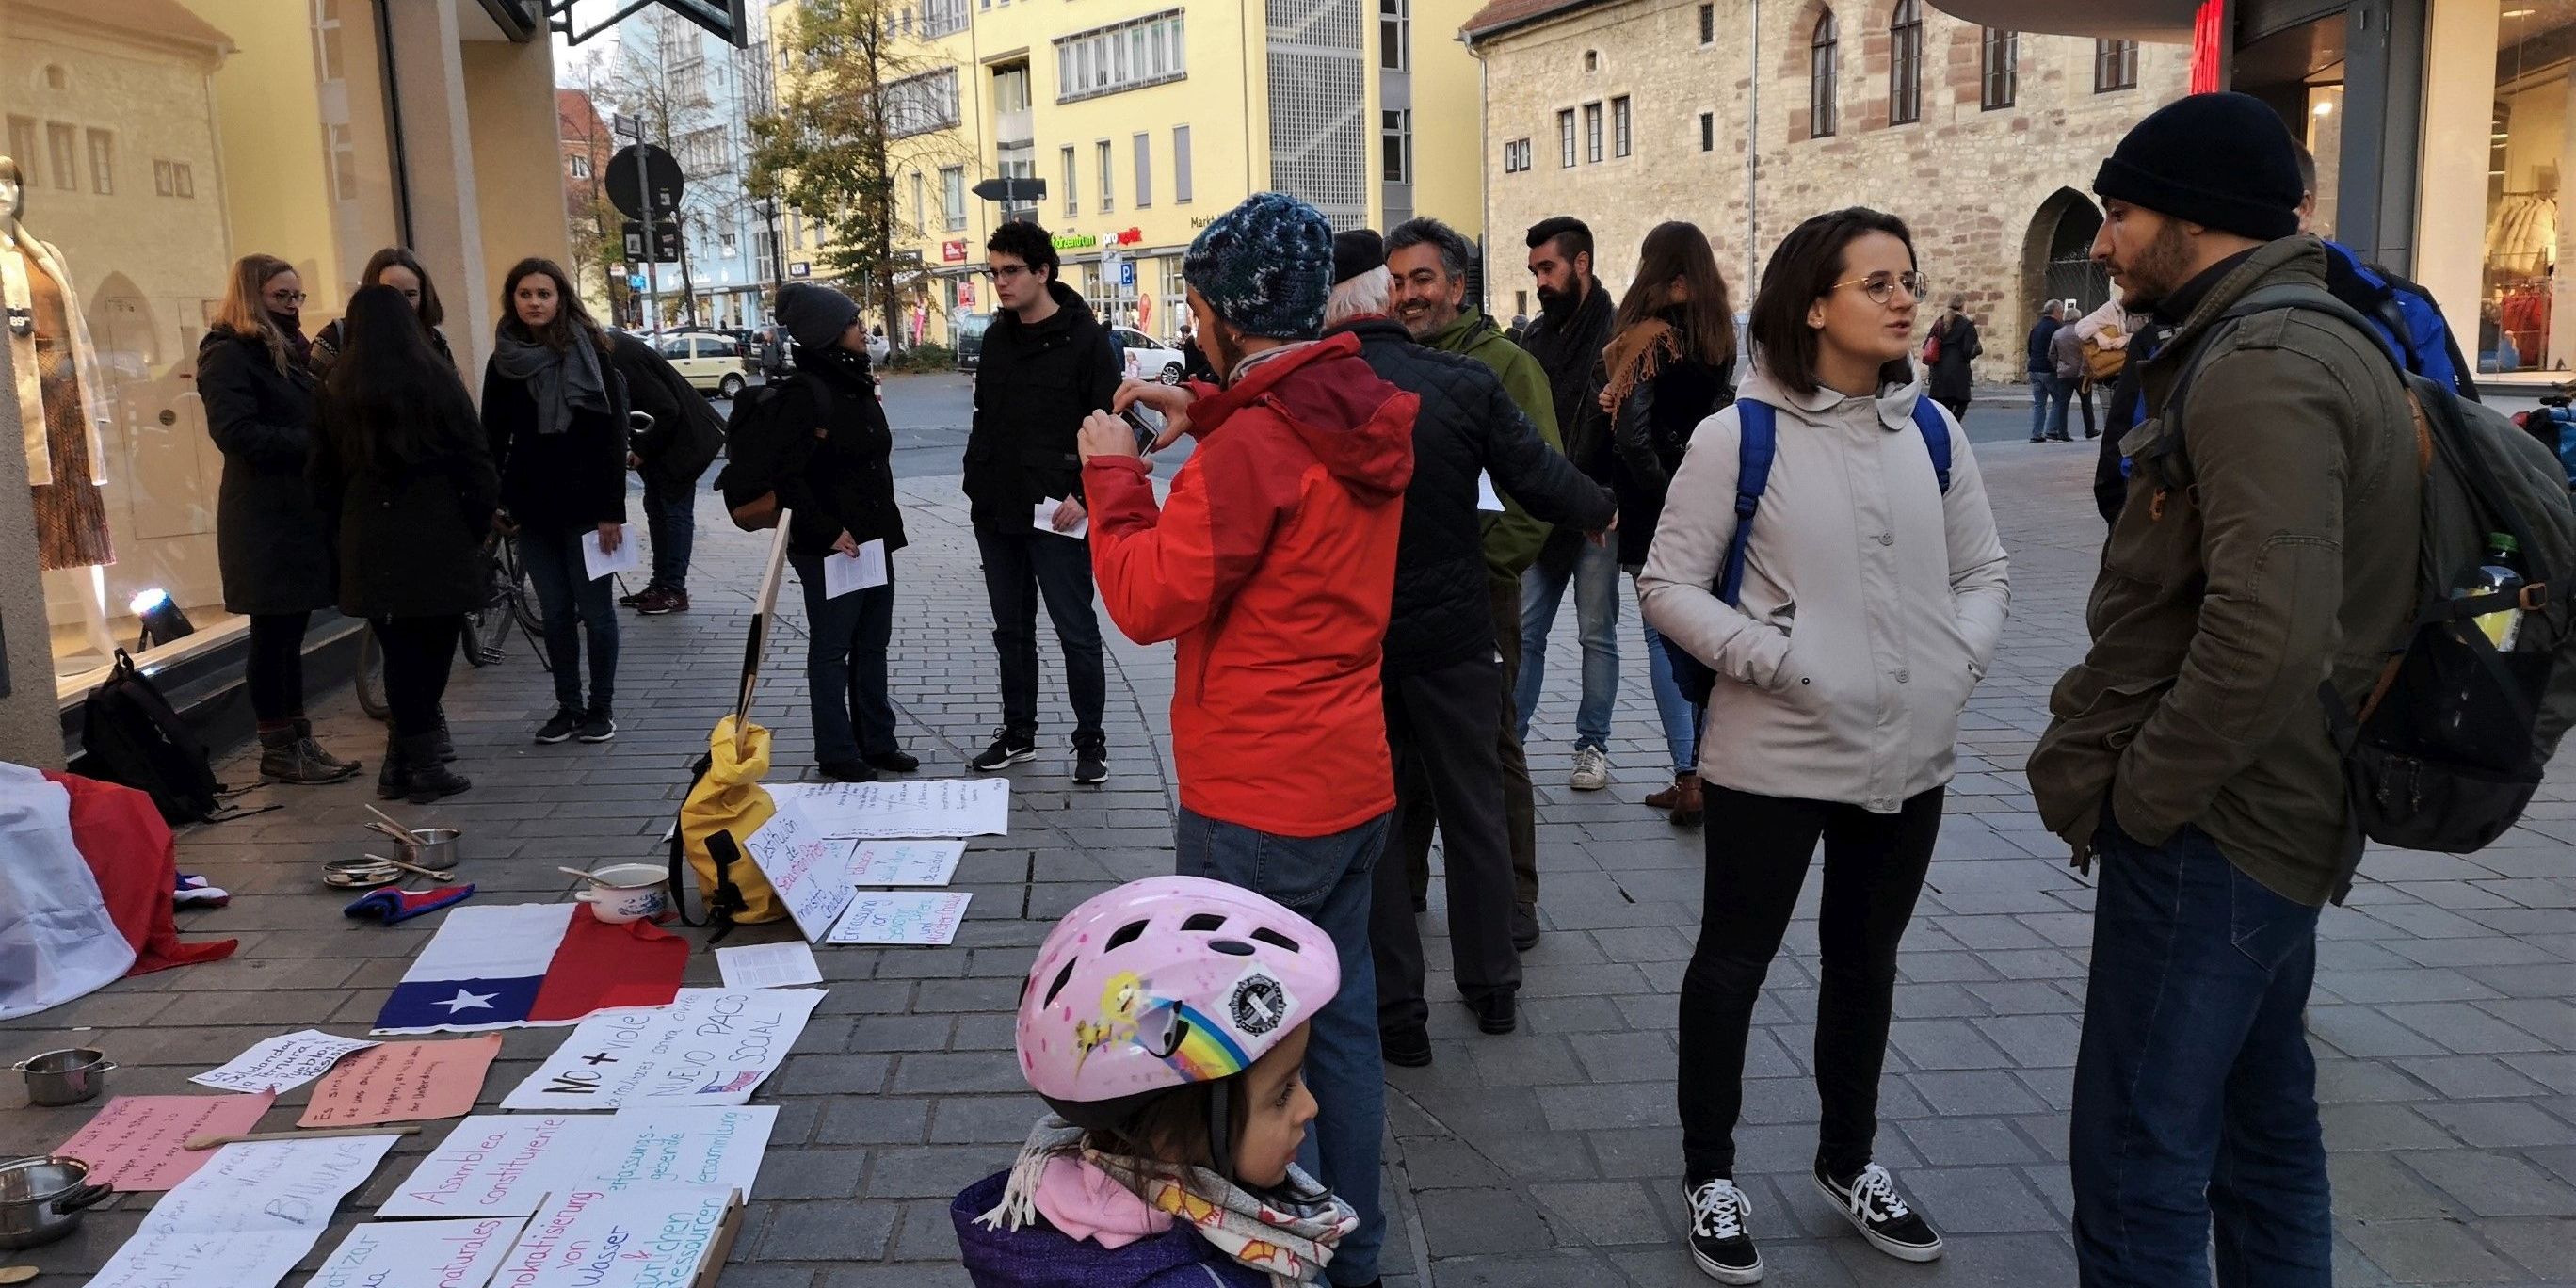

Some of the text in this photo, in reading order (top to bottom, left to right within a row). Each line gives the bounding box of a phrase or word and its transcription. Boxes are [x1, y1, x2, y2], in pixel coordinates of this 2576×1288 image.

[728, 1011, 783, 1065] SOCIAL
[541, 1070, 602, 1094] NO
[646, 1050, 716, 1098] NUEVO
[313, 1107, 334, 1121] Es
[408, 1129, 508, 1206] Asamblea
[479, 1118, 567, 1206] constituyente
[430, 1220, 502, 1288] naturales
[556, 1240, 591, 1270] von
[571, 1225, 629, 1287] Wasser
